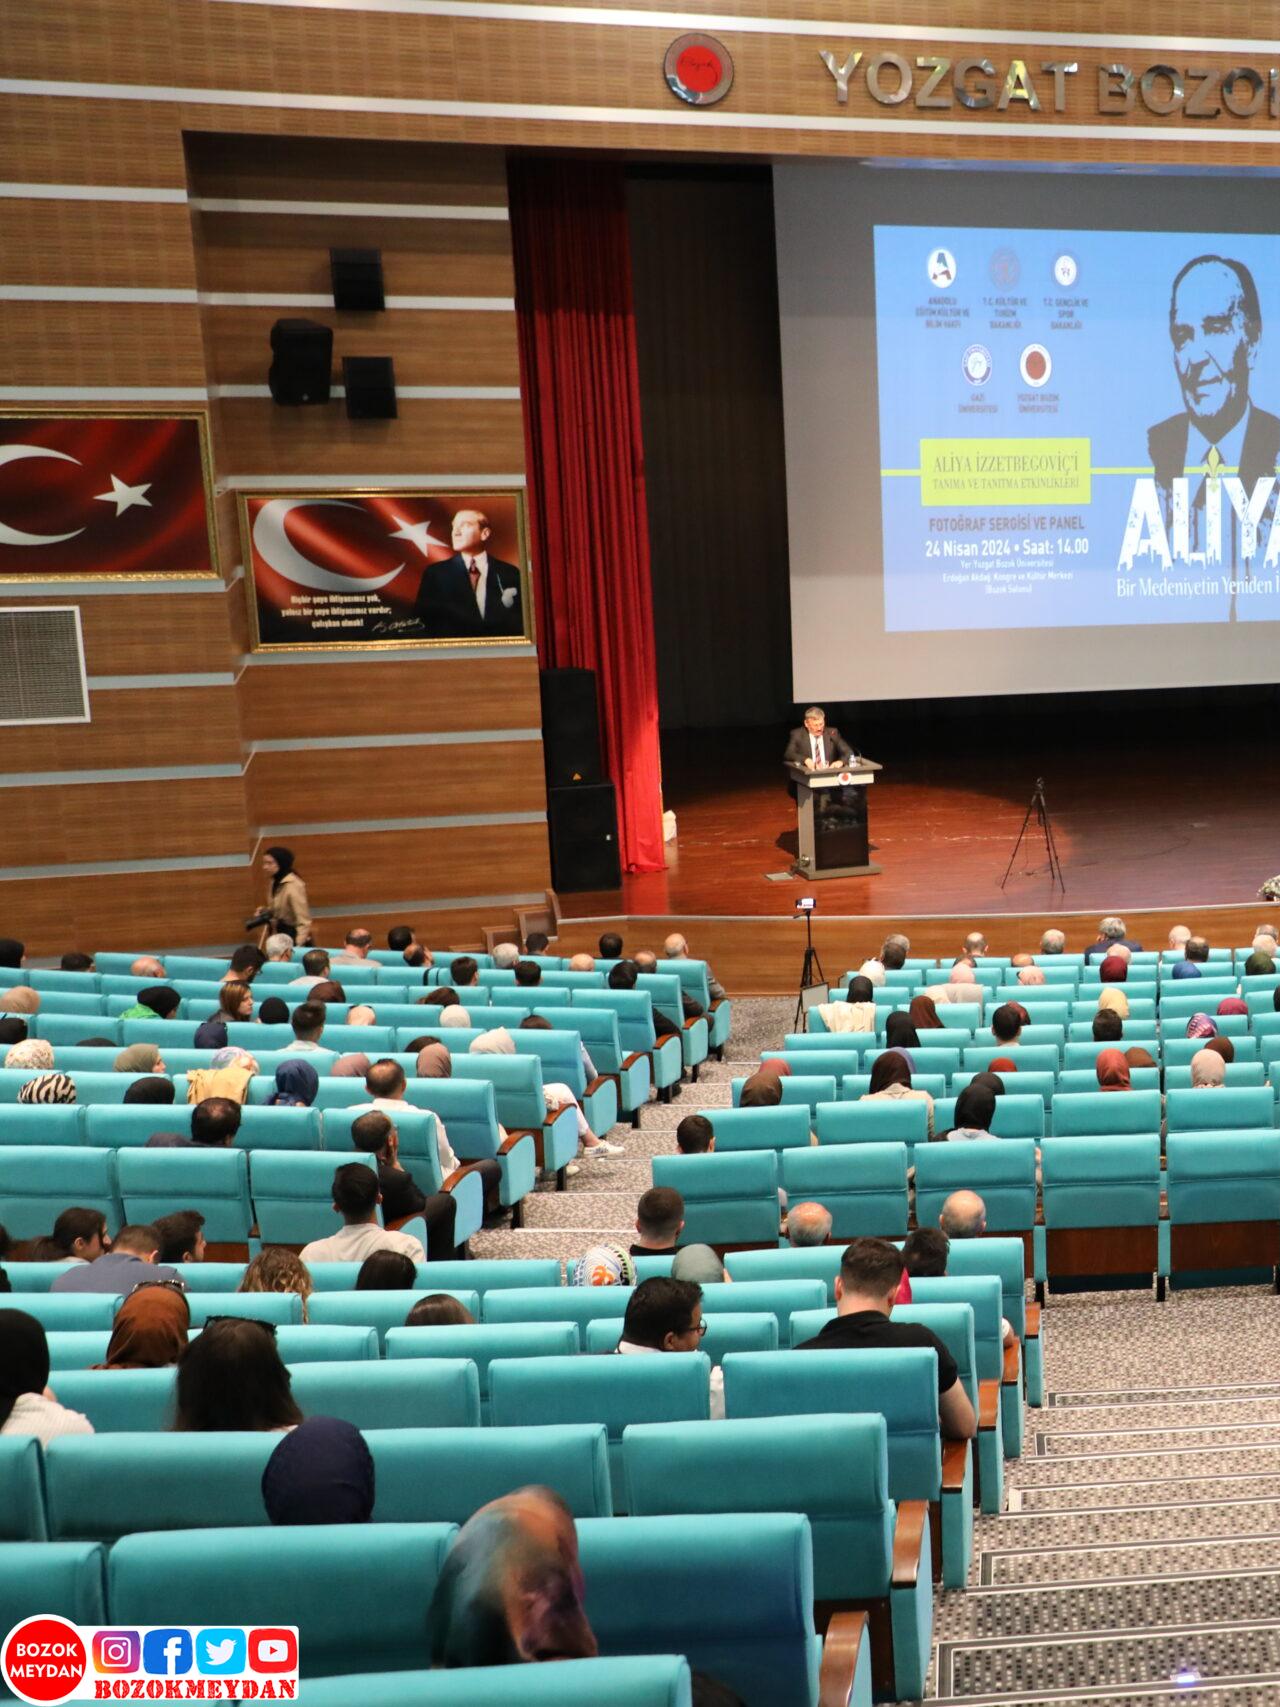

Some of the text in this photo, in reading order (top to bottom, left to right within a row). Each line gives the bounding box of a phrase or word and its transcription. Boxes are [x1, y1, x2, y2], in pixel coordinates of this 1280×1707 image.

[818, 49, 1078, 112] YOZGAT
[933, 452, 971, 473] ALİYA
[933, 478, 966, 490] TANIMA
[969, 478, 979, 489] VE
[981, 478, 1019, 489] TANITMA
[929, 513, 1085, 532] FOTOĞRAF SERGİSİ VE PANEL
[925, 537, 1089, 557] 24 Nisan 2024 Saat: 14.00
[1117, 578, 1136, 597] Bir
[1139, 576, 1219, 599] Medeniyetin
[1222, 575, 1272, 595] Yeniden
